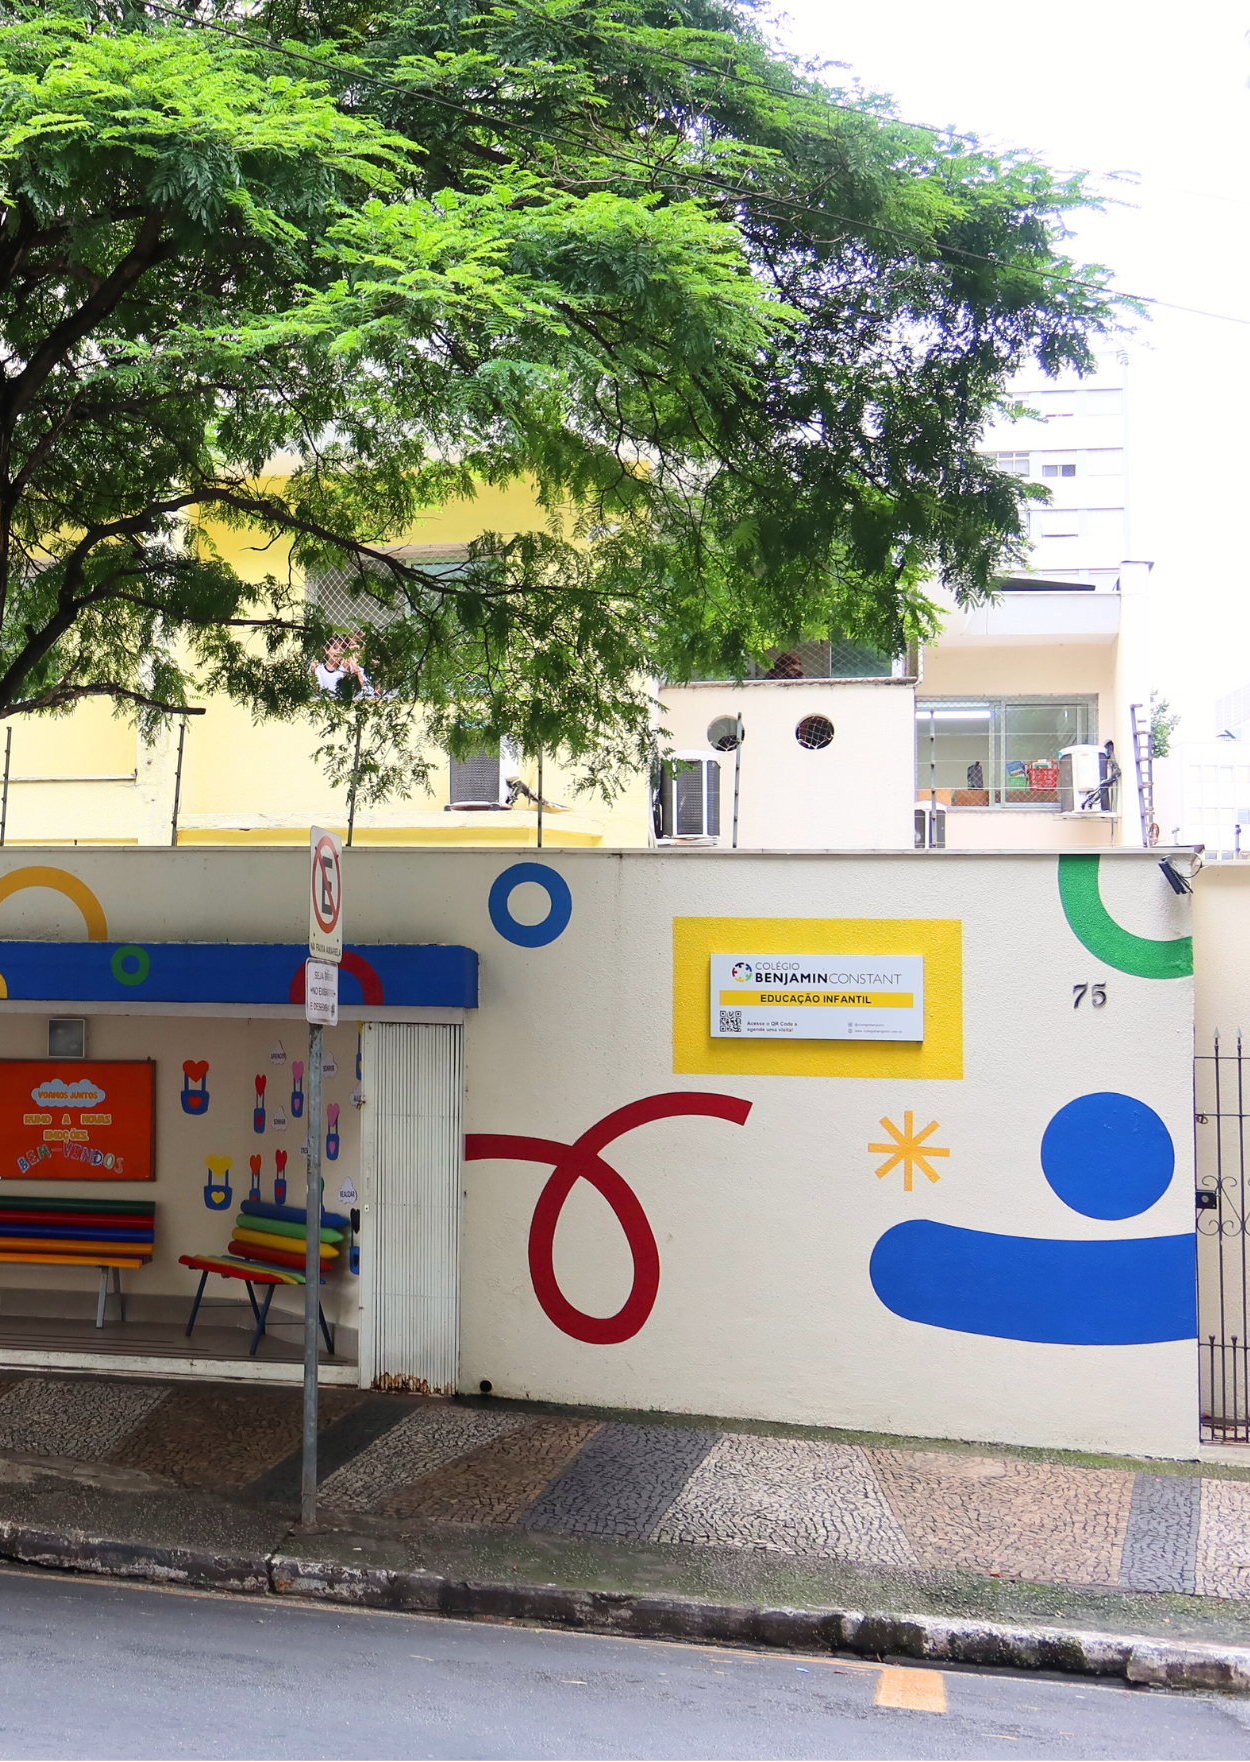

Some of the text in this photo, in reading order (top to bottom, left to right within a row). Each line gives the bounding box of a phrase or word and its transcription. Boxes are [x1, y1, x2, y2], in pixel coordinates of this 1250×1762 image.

[755, 961, 800, 971] COLÉGIO
[760, 993, 872, 1005] EDUCAÇÃO INFANTIL
[1072, 981, 1107, 1010] 75
[70, 1091, 98, 1100] JUNTOS
[23, 1114, 112, 1125] RUMO A NOVAS
